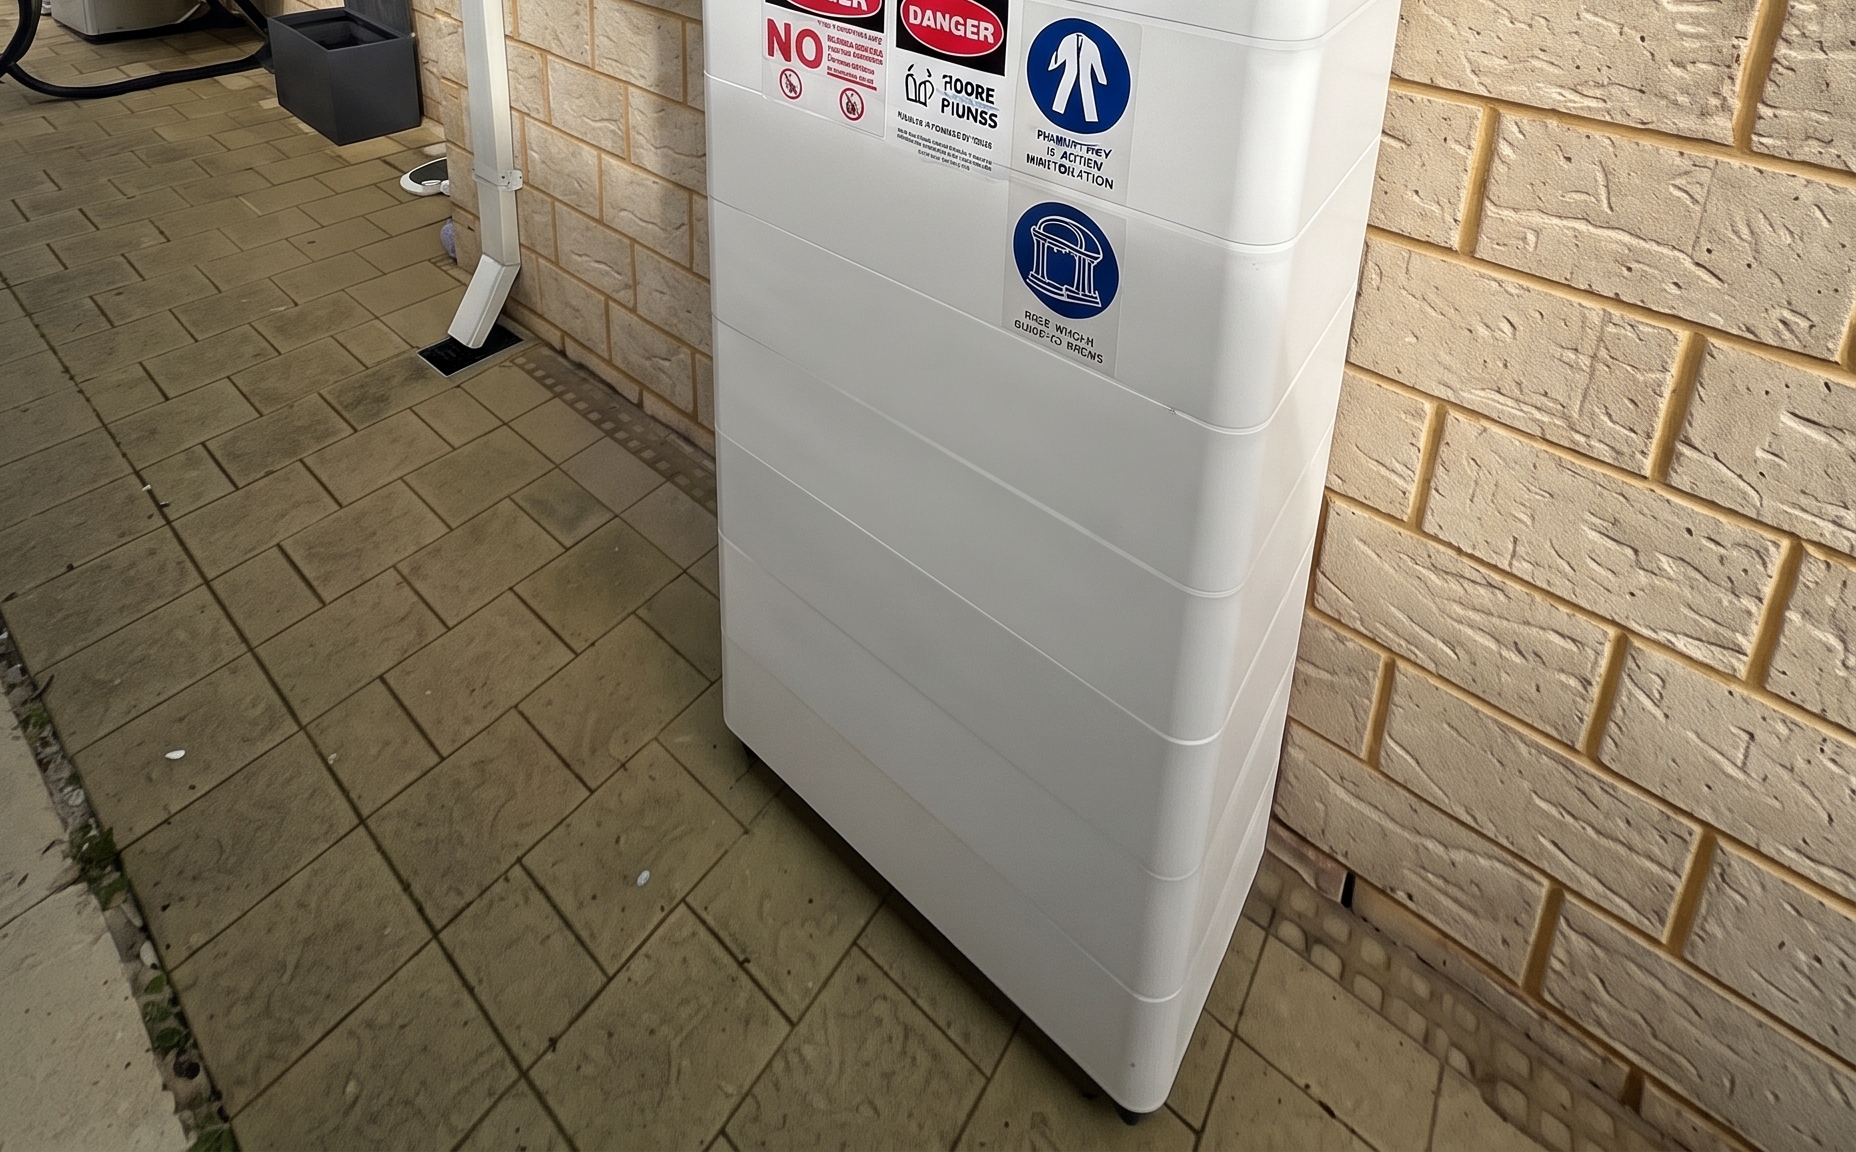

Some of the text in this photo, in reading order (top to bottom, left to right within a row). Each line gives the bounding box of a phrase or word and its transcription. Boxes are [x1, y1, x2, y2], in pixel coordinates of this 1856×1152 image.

[767, 17, 824, 69] NO
[908, 4, 995, 44] DANGER
[1046, 146, 1056, 157] IS
